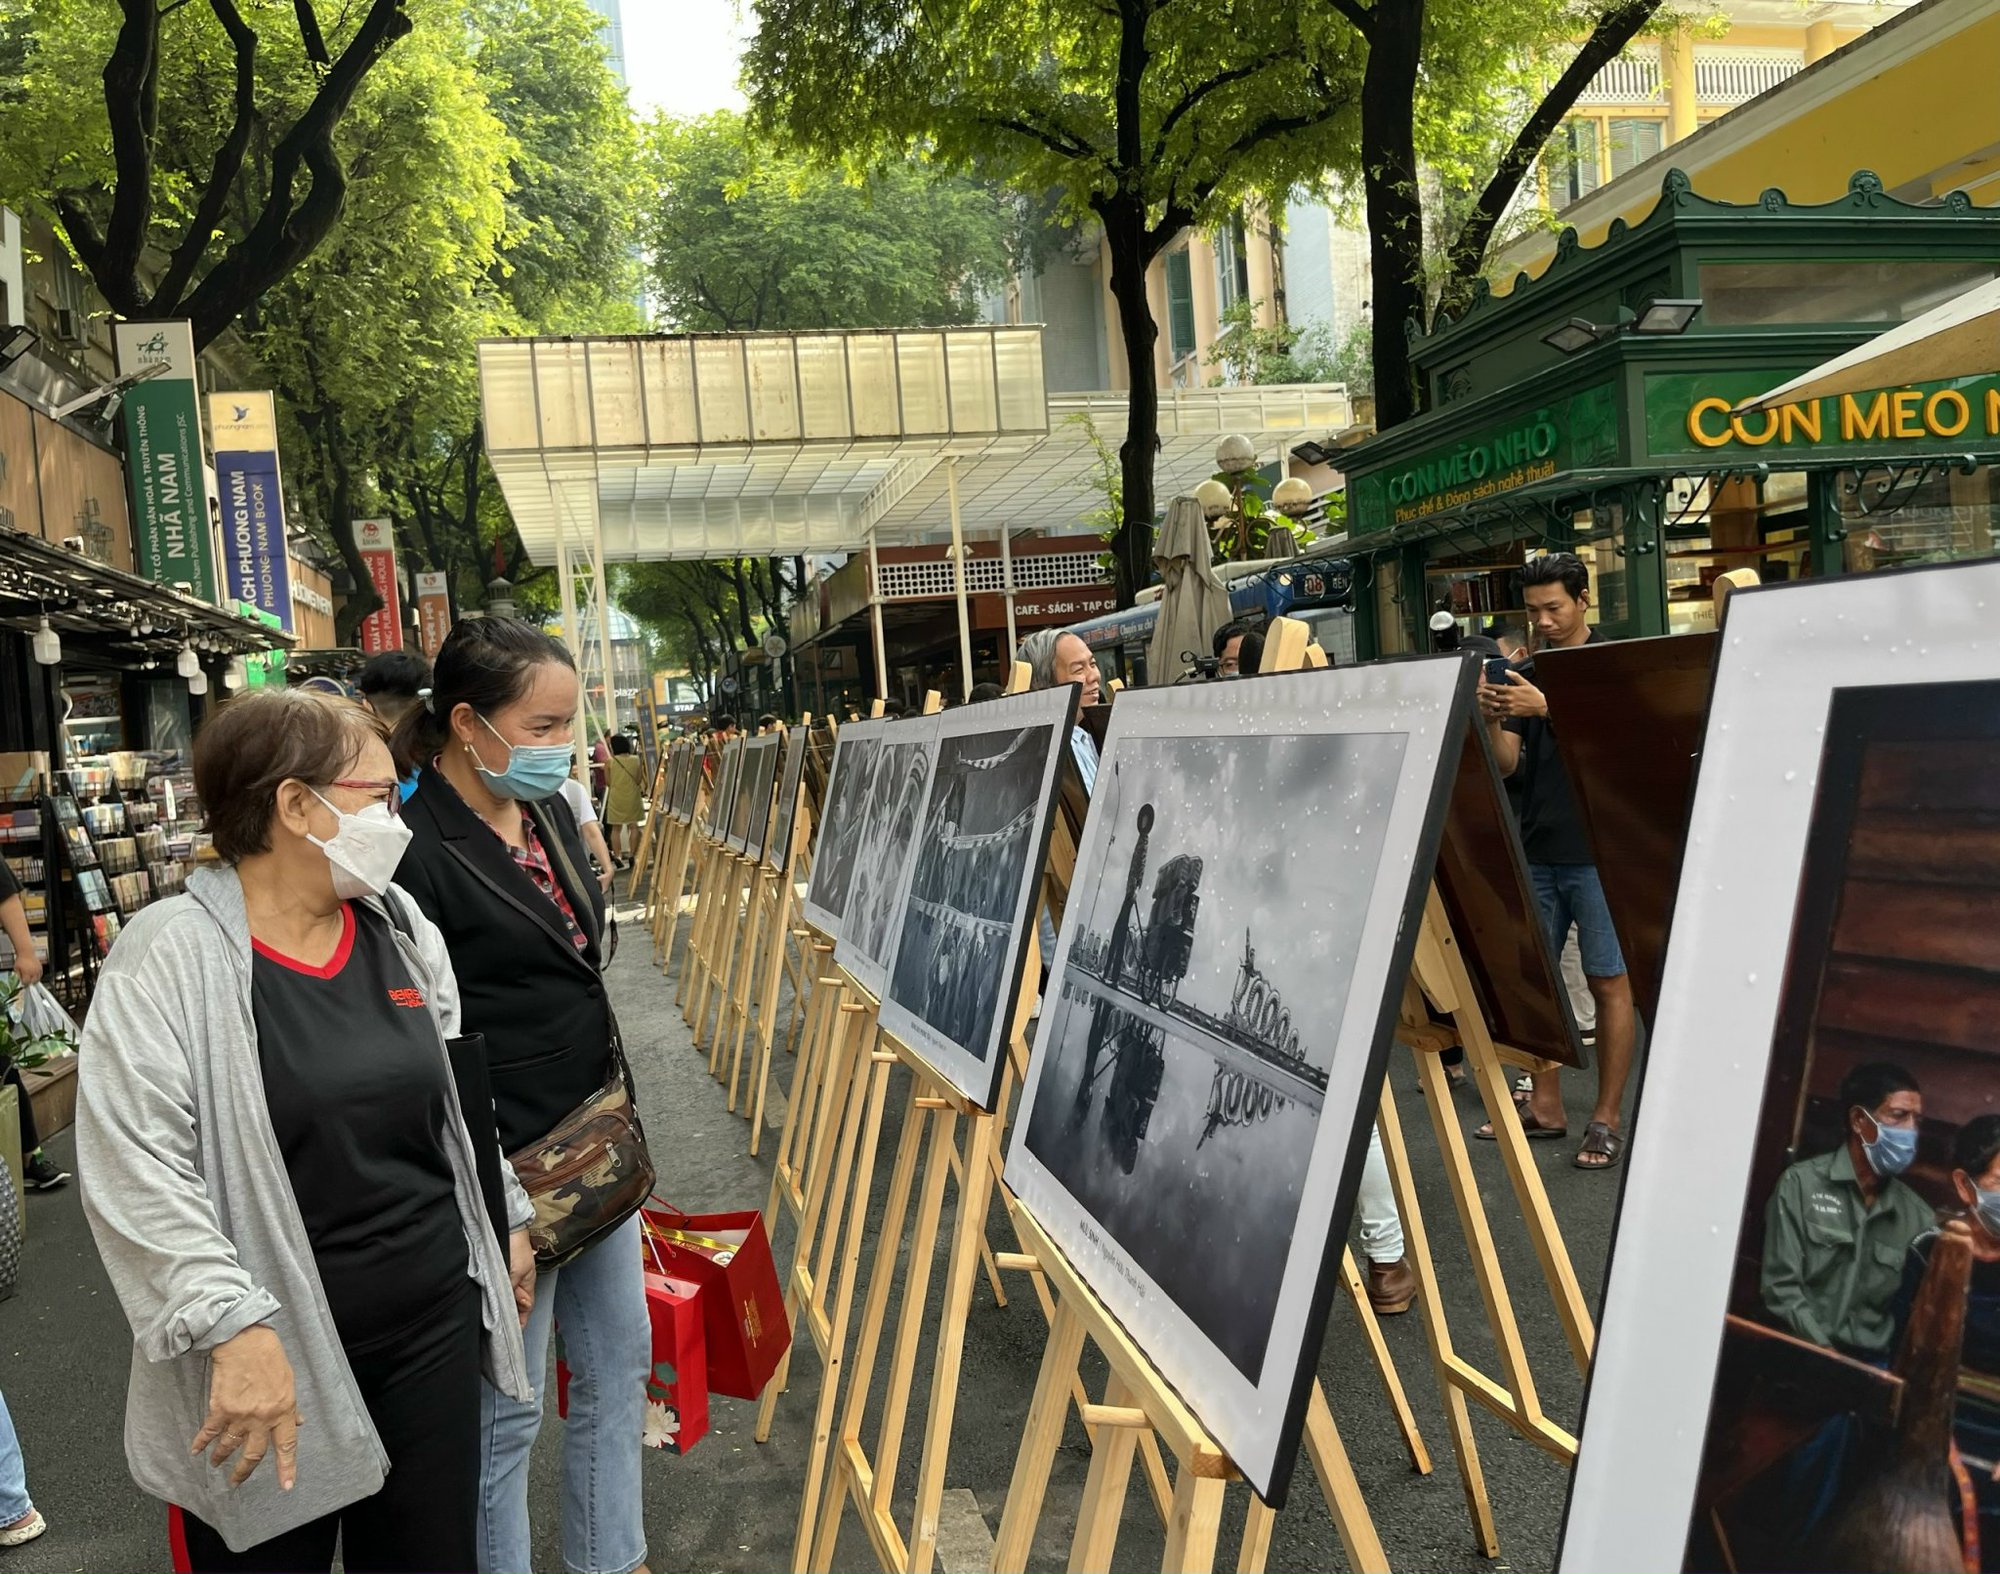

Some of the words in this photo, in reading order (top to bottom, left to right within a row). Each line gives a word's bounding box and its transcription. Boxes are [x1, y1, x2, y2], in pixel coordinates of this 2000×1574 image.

[1686, 396, 1822, 448] CON
[157, 453, 180, 505] NAM
[178, 429, 194, 498] Communications
[1389, 463, 1436, 506] CON
[1438, 443, 1491, 490] MÈO
[1494, 410, 1558, 471] NHỎ
[185, 498, 195, 515] and
[230, 470, 248, 507] NAM
[252, 483, 266, 519] BOOK
[1436, 496, 1445, 511] &
[1473, 479, 1497, 499] sách
[159, 509, 186, 559] NHÃ
[187, 515, 200, 558] Publishing
[234, 507, 255, 574] PHƯƠNG
[256, 522, 269, 552] NAM
[259, 556, 274, 608] PHUONG
[1015, 604, 1040, 616] CAFE
[1047, 601, 1074, 614] SÁCH
[1082, 601, 1102, 614] TẠP
